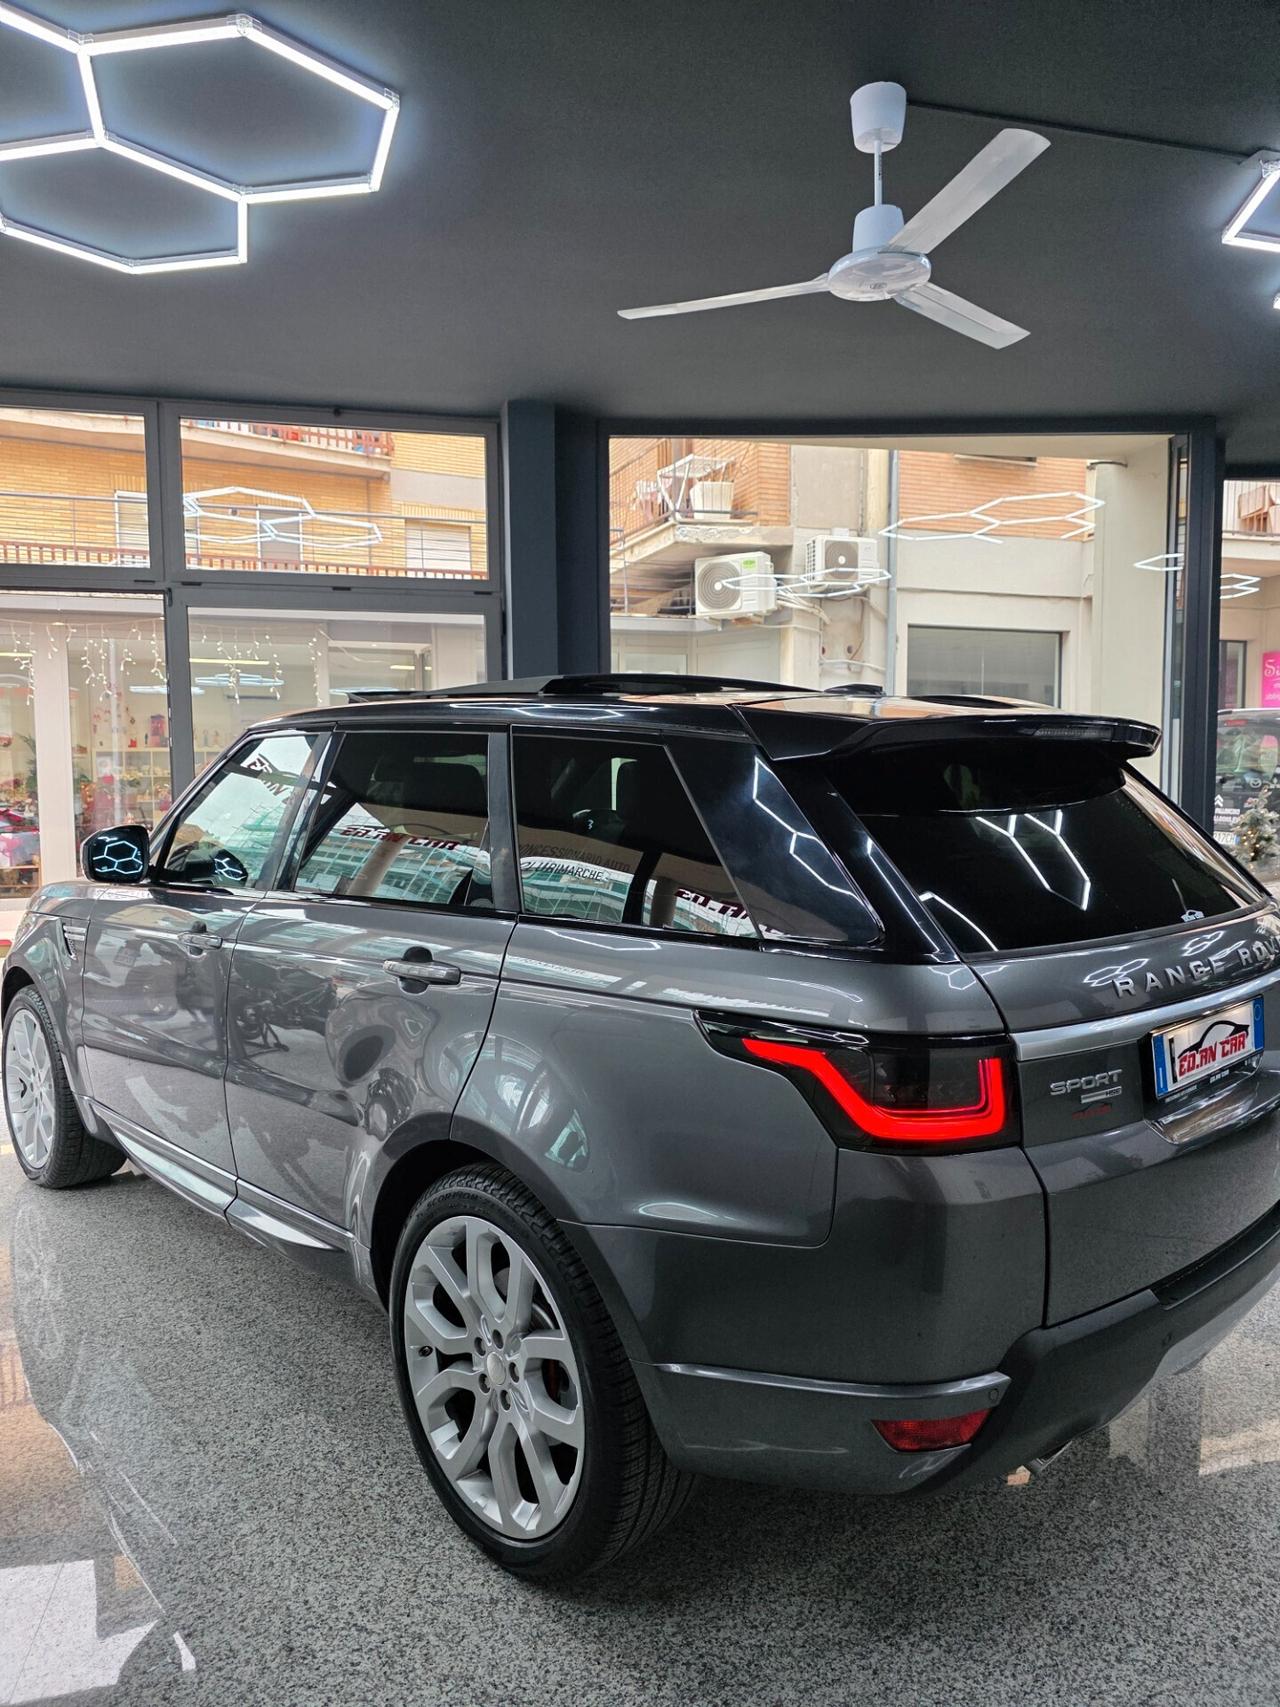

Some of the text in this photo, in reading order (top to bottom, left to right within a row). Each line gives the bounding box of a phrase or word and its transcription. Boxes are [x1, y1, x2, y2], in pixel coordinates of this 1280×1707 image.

[1112, 956, 1225, 998] RANGE
[1177, 1042, 1218, 1077] ED.AN
[1219, 1030, 1246, 1059] CAR
[1050, 1068, 1122, 1096] SPORT
